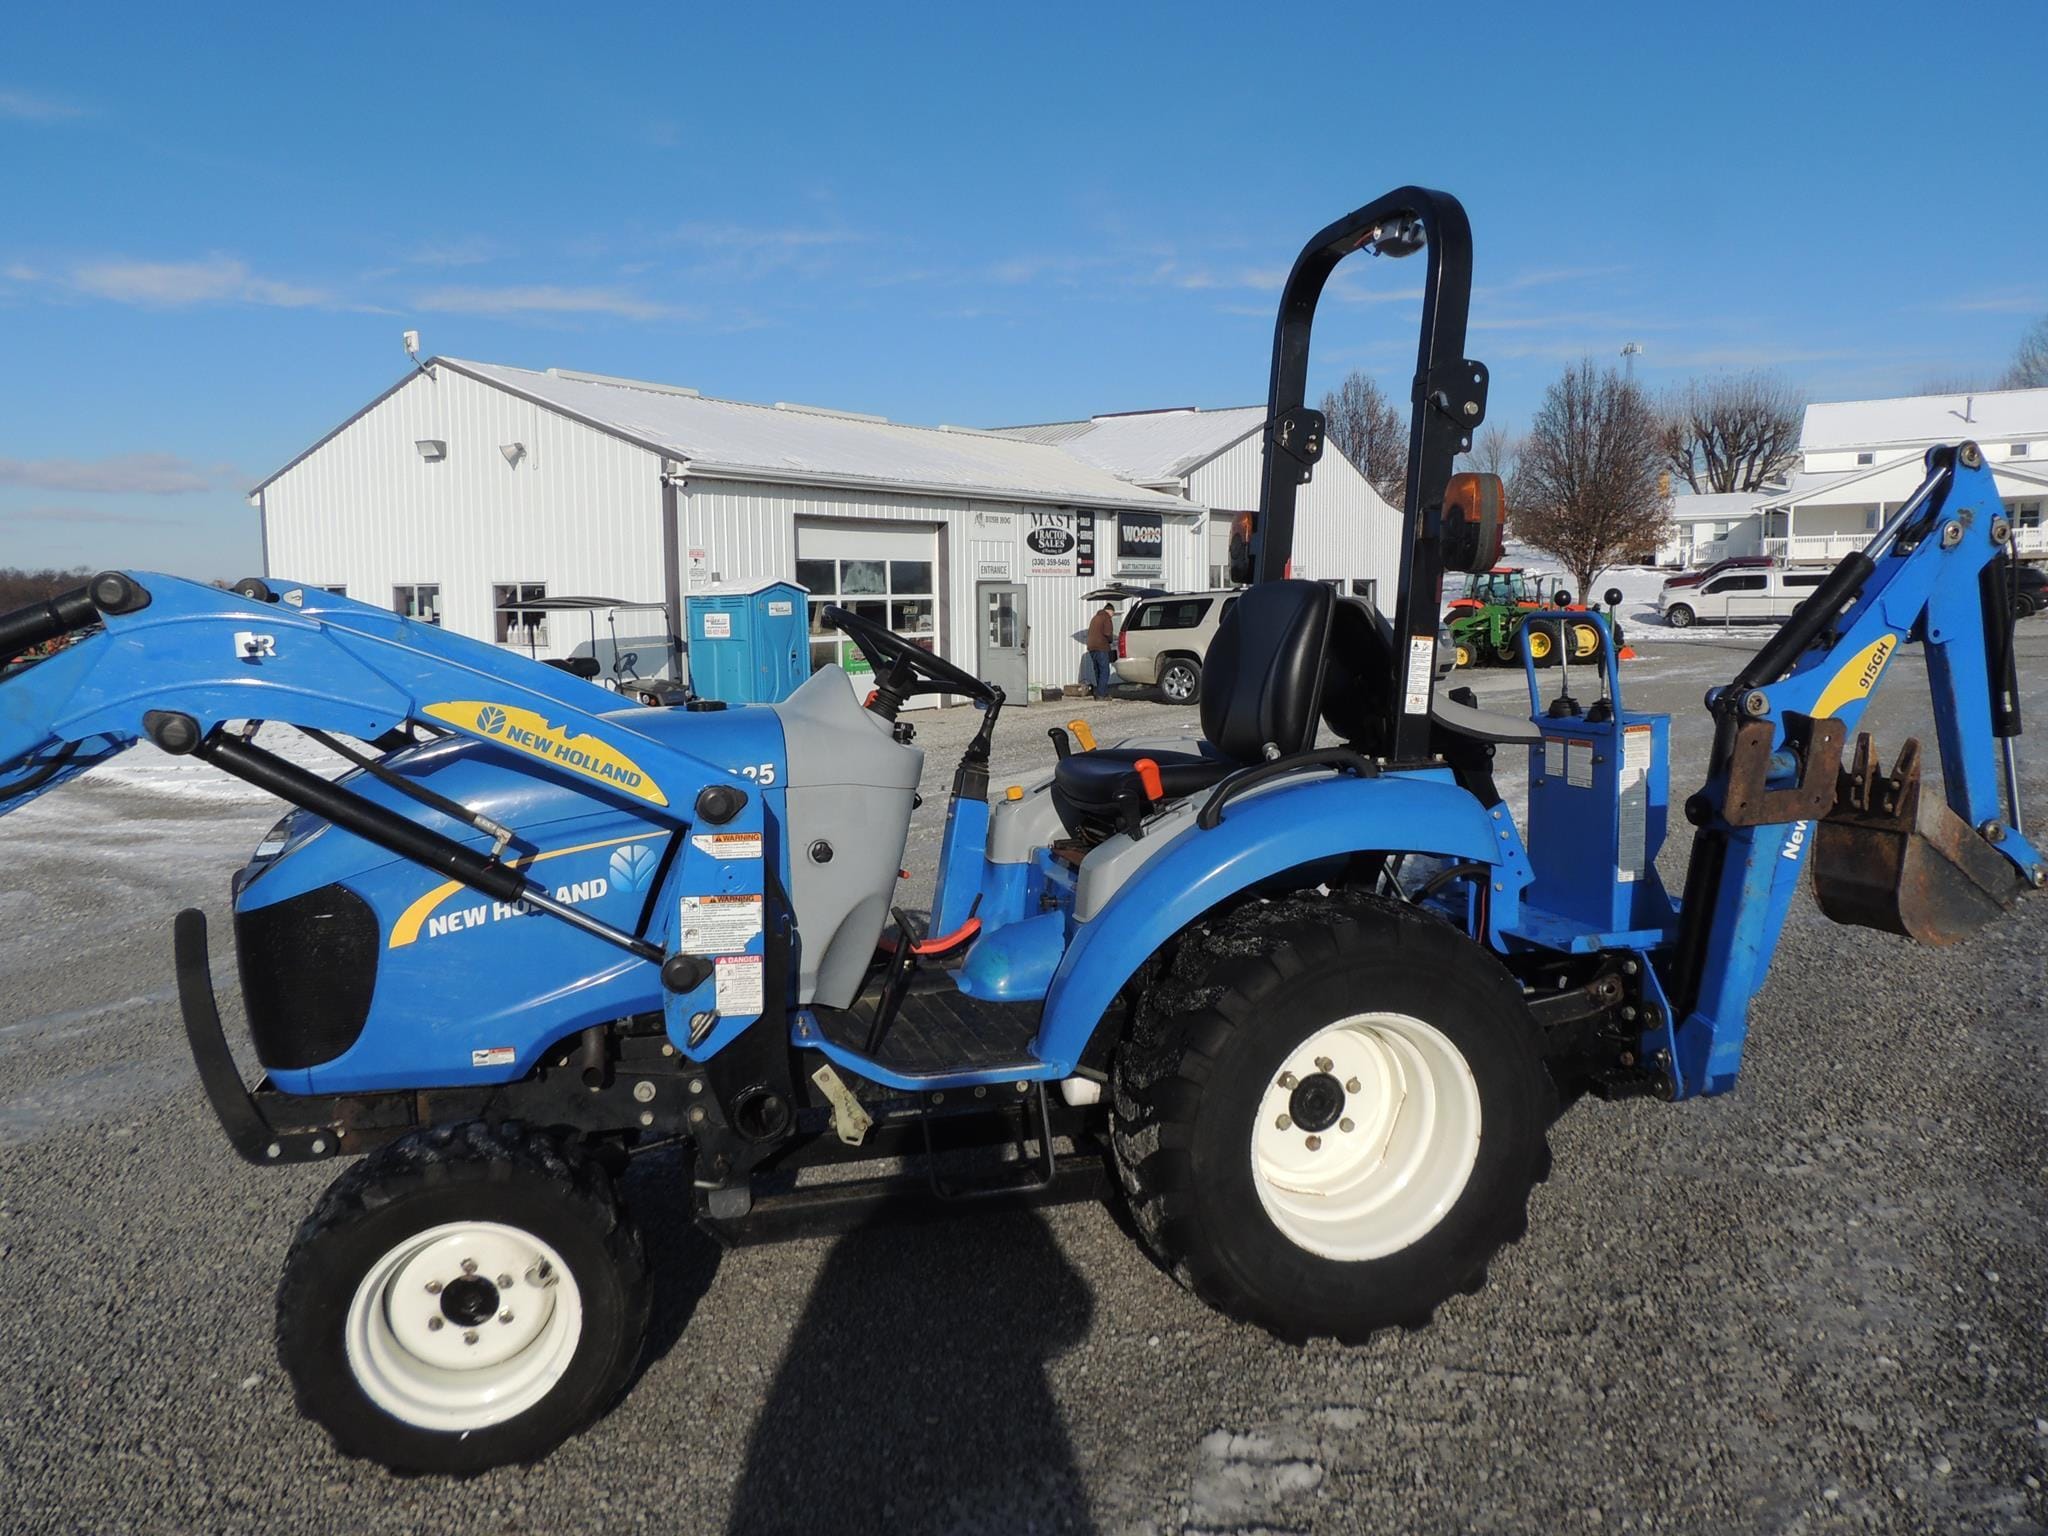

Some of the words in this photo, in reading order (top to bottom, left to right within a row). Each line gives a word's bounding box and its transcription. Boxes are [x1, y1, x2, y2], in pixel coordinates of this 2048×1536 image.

[1030, 512, 1073, 529] MAST
[1034, 527, 1067, 540] TRACTOR
[1122, 525, 1161, 543] WOODS
[1038, 539, 1065, 548] SALES
[981, 565, 1007, 575] ENTRANCE
[1859, 641, 1889, 689] 915GH
[506, 724, 553, 753] NEW
[554, 743, 642, 788] HOLLAND
[723, 833, 760, 842] WARNING
[717, 895, 754, 903] WARNING
[428, 904, 487, 937] NEW
[728, 955, 760, 963] DANGER
